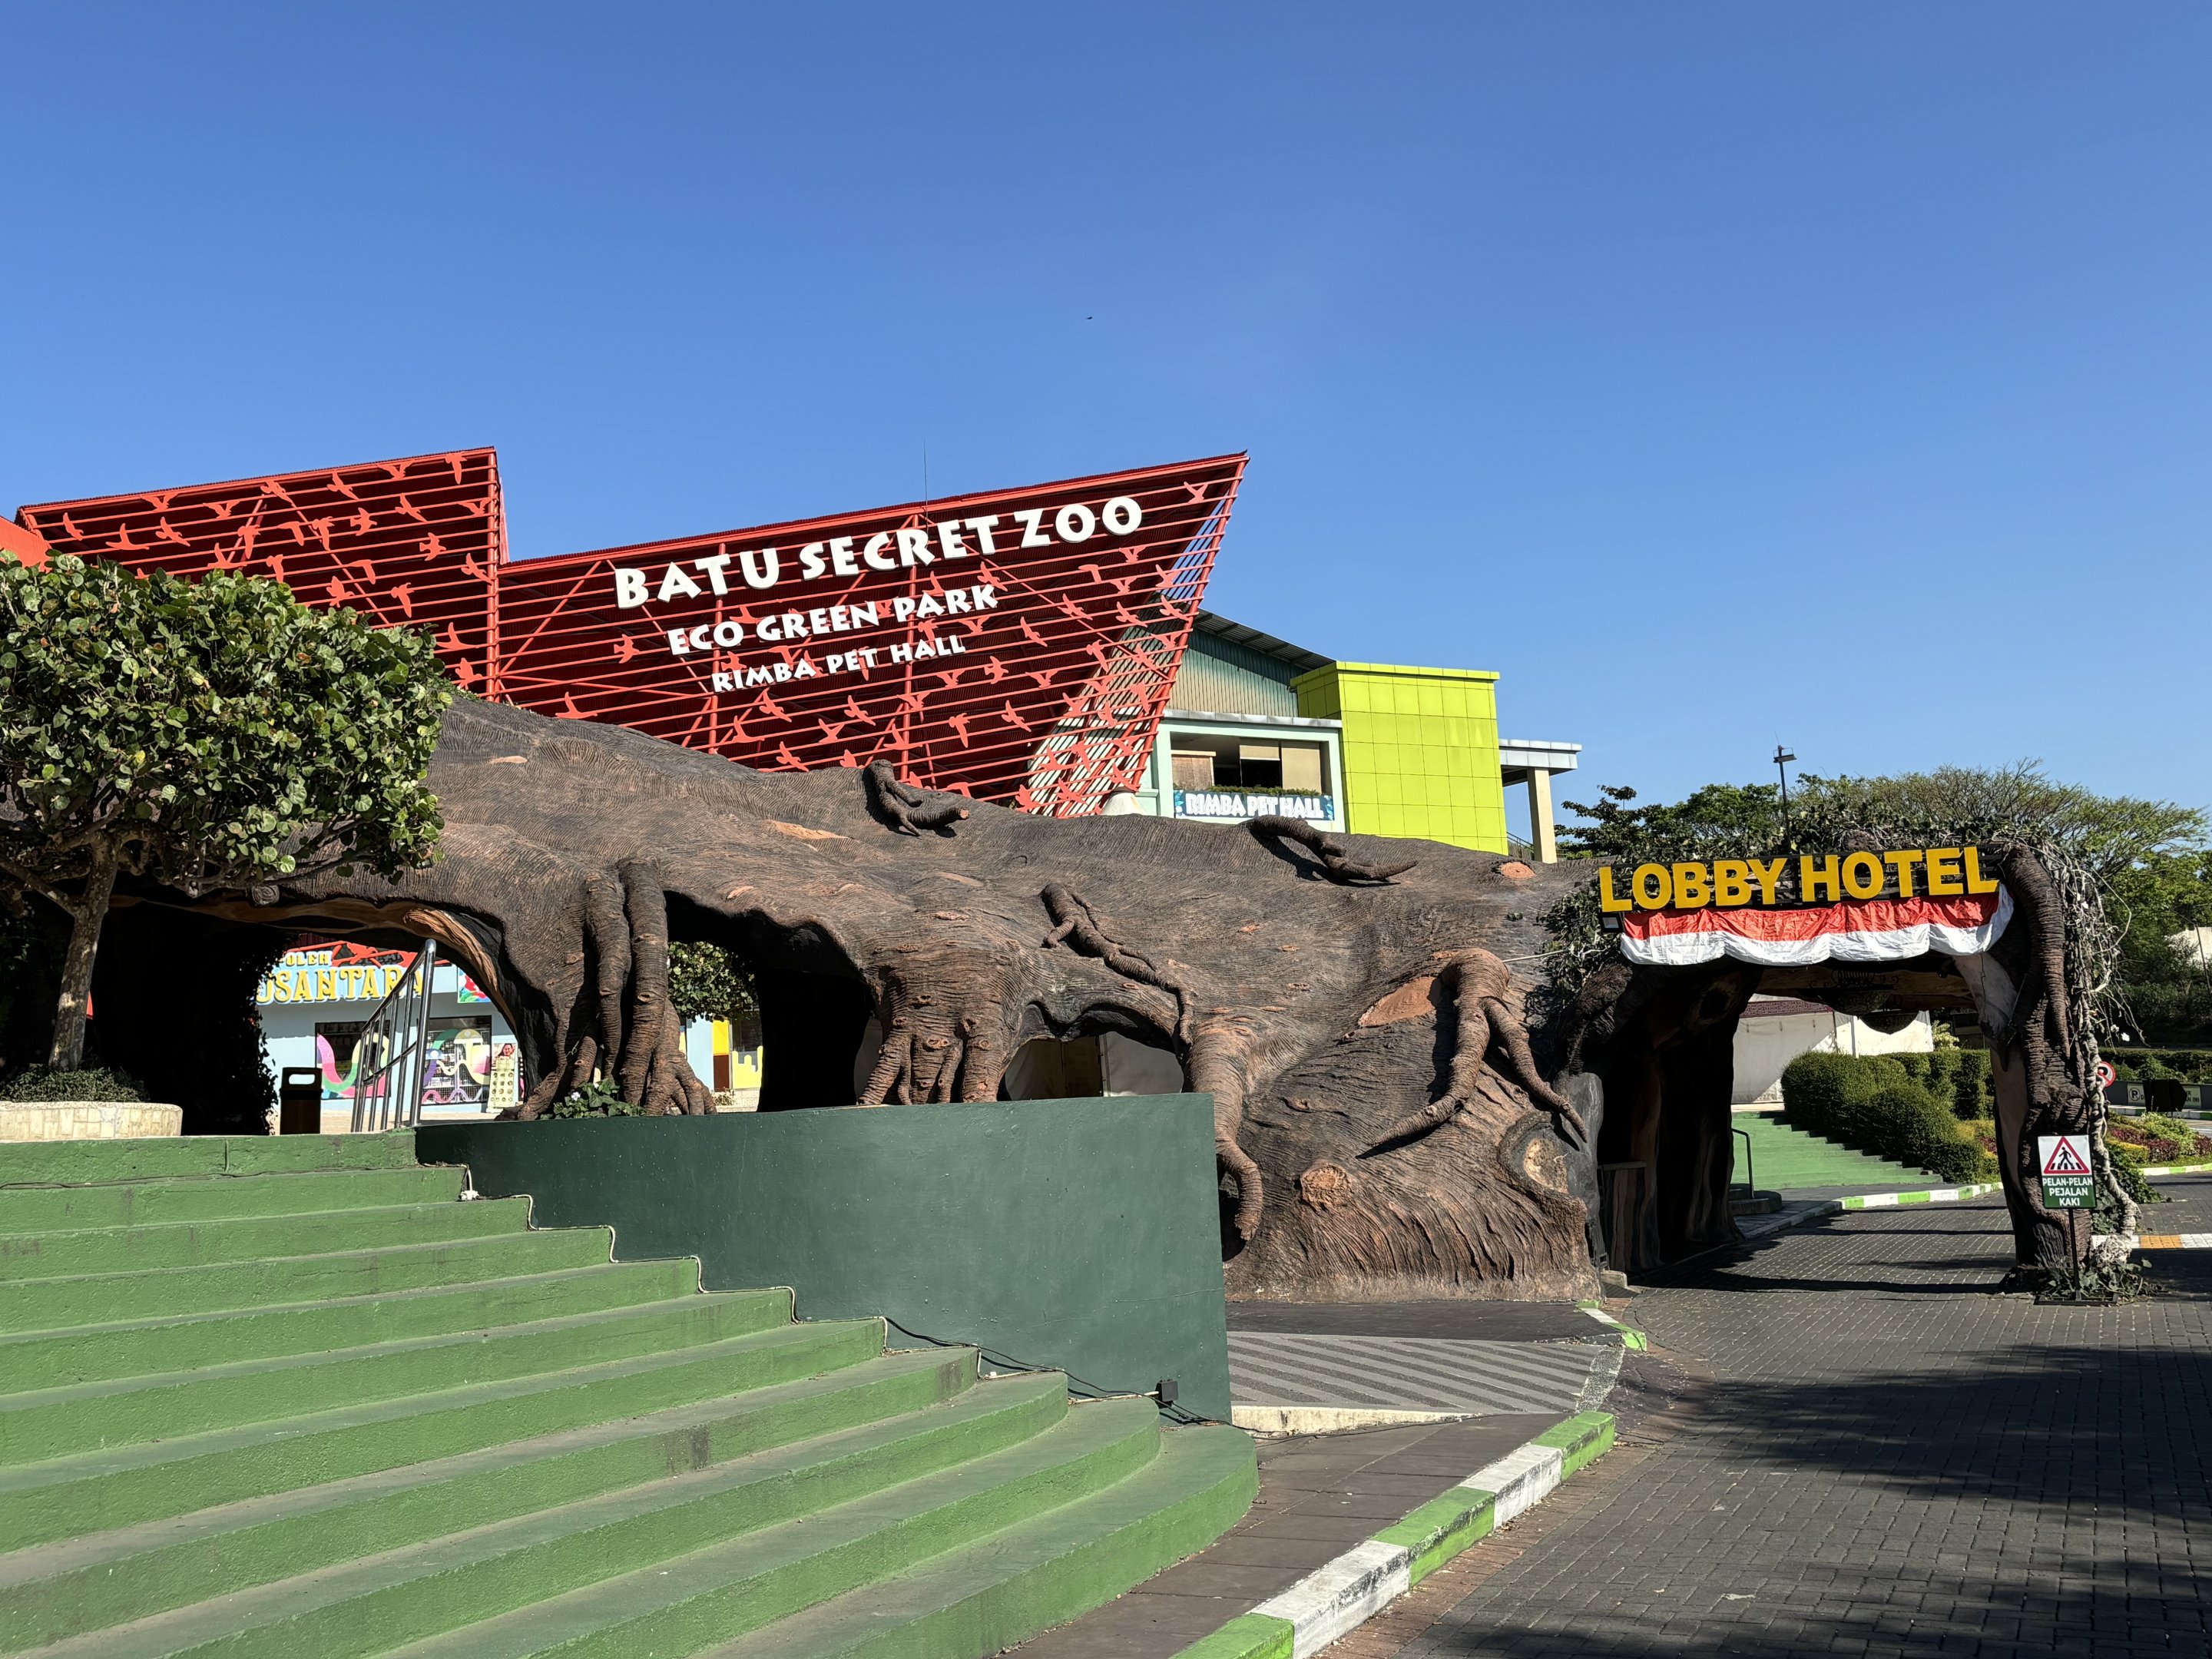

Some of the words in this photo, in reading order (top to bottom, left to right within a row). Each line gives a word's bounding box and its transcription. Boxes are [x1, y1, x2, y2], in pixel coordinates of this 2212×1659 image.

[614, 548, 781, 609] BATU
[800, 515, 998, 581] SECRET
[1014, 496, 1143, 548] ZOO
[667, 621, 743, 655] ECO
[757, 601, 879, 642] GREEN
[892, 584, 998, 623] PARK
[712, 658, 816, 693] RIMBA
[827, 647, 877, 674] PET
[891, 634, 965, 664] HALL
[1185, 793, 1247, 816] RIMBA
[1247, 796, 1279, 816] PET
[1279, 796, 1324, 819] HALL
[1599, 858, 1788, 912] LOBBY
[1800, 846, 1998, 902] HOTEL
[2043, 1177, 2093, 1187] PELAN-PELAN
[2049, 1187, 2088, 1197] PEJALAN
[2059, 1197, 2080, 1207] KAKI
